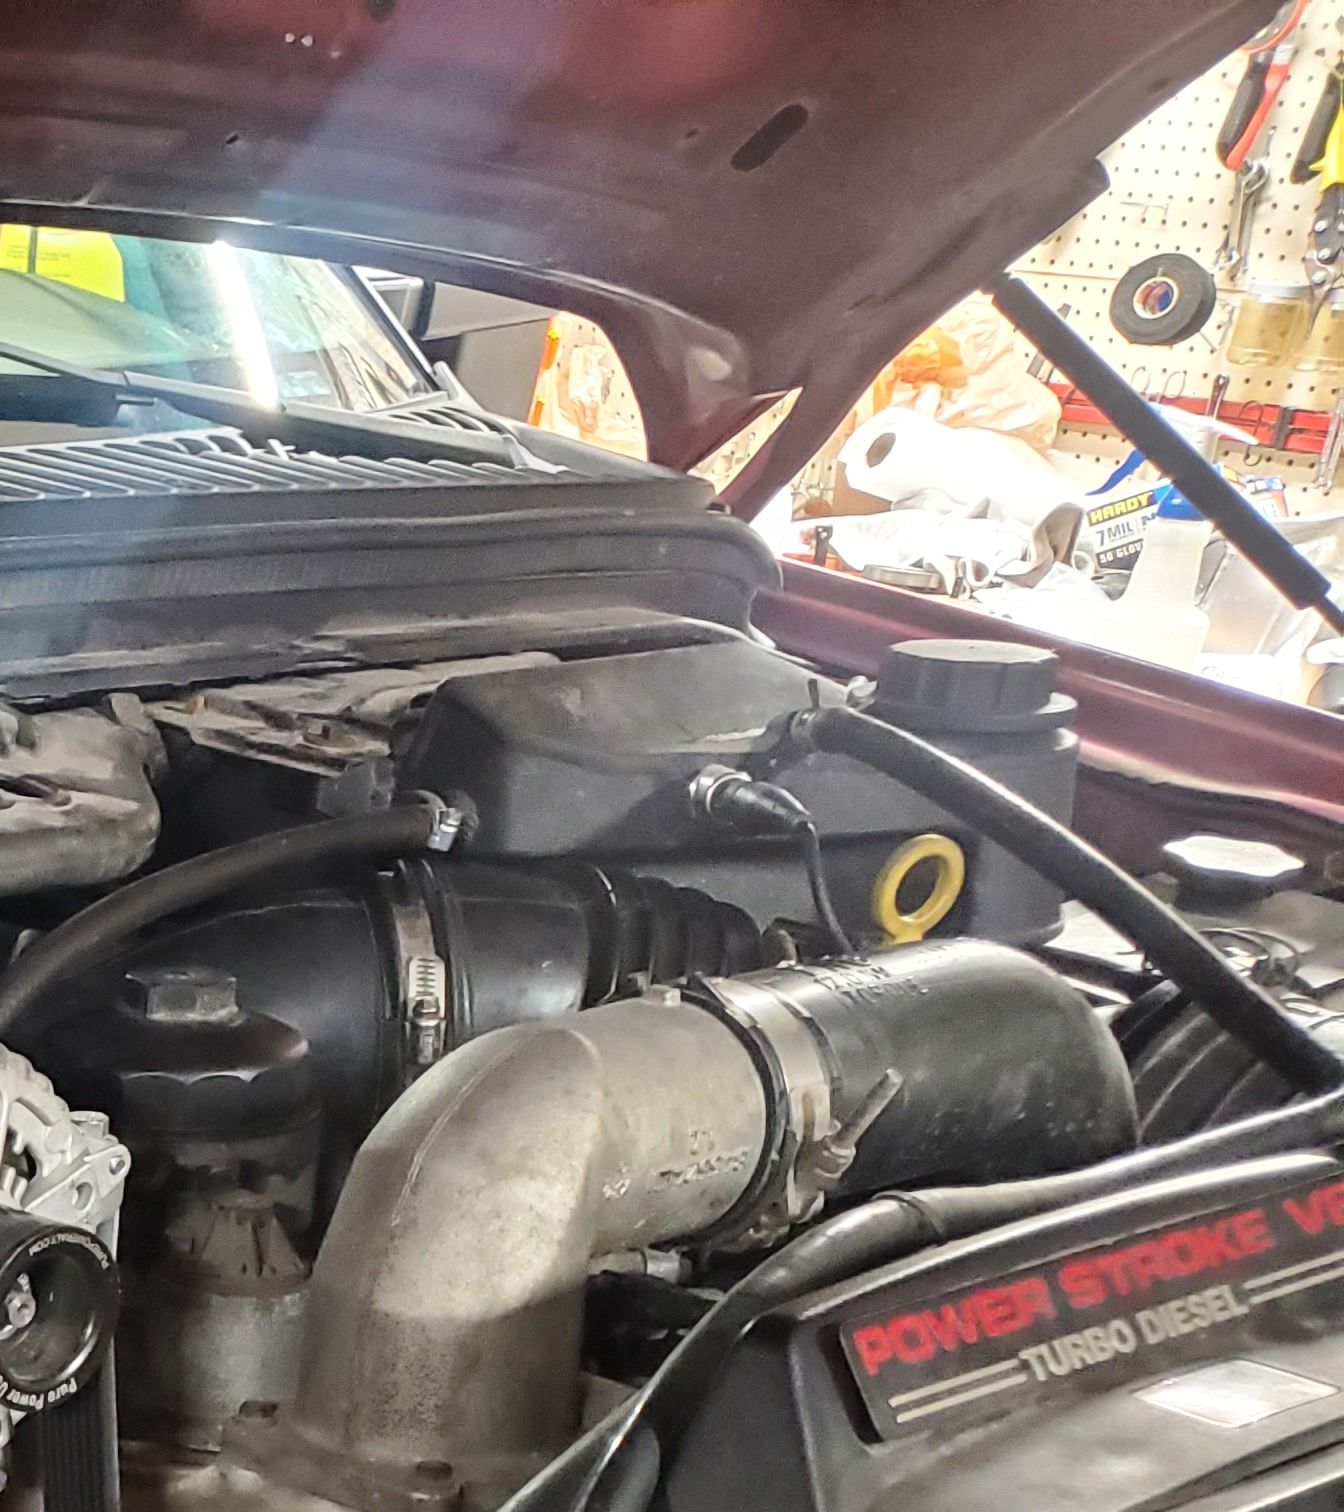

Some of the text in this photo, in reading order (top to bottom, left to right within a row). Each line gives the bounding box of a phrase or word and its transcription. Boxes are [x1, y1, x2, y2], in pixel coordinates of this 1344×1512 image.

[1087, 492, 1155, 523] HARDY
[1095, 521, 1134, 546] 7 MIL
[1098, 541, 1144, 563] 50 GLOV
[851, 1264, 1056, 1380] POWER
[1055, 1196, 1276, 1319] STROKE
[1018, 1276, 1249, 1388] TURBO DIESEL
[6, 1389, 44, 1410] Power
[47, 1377, 77, 1402] Pure
